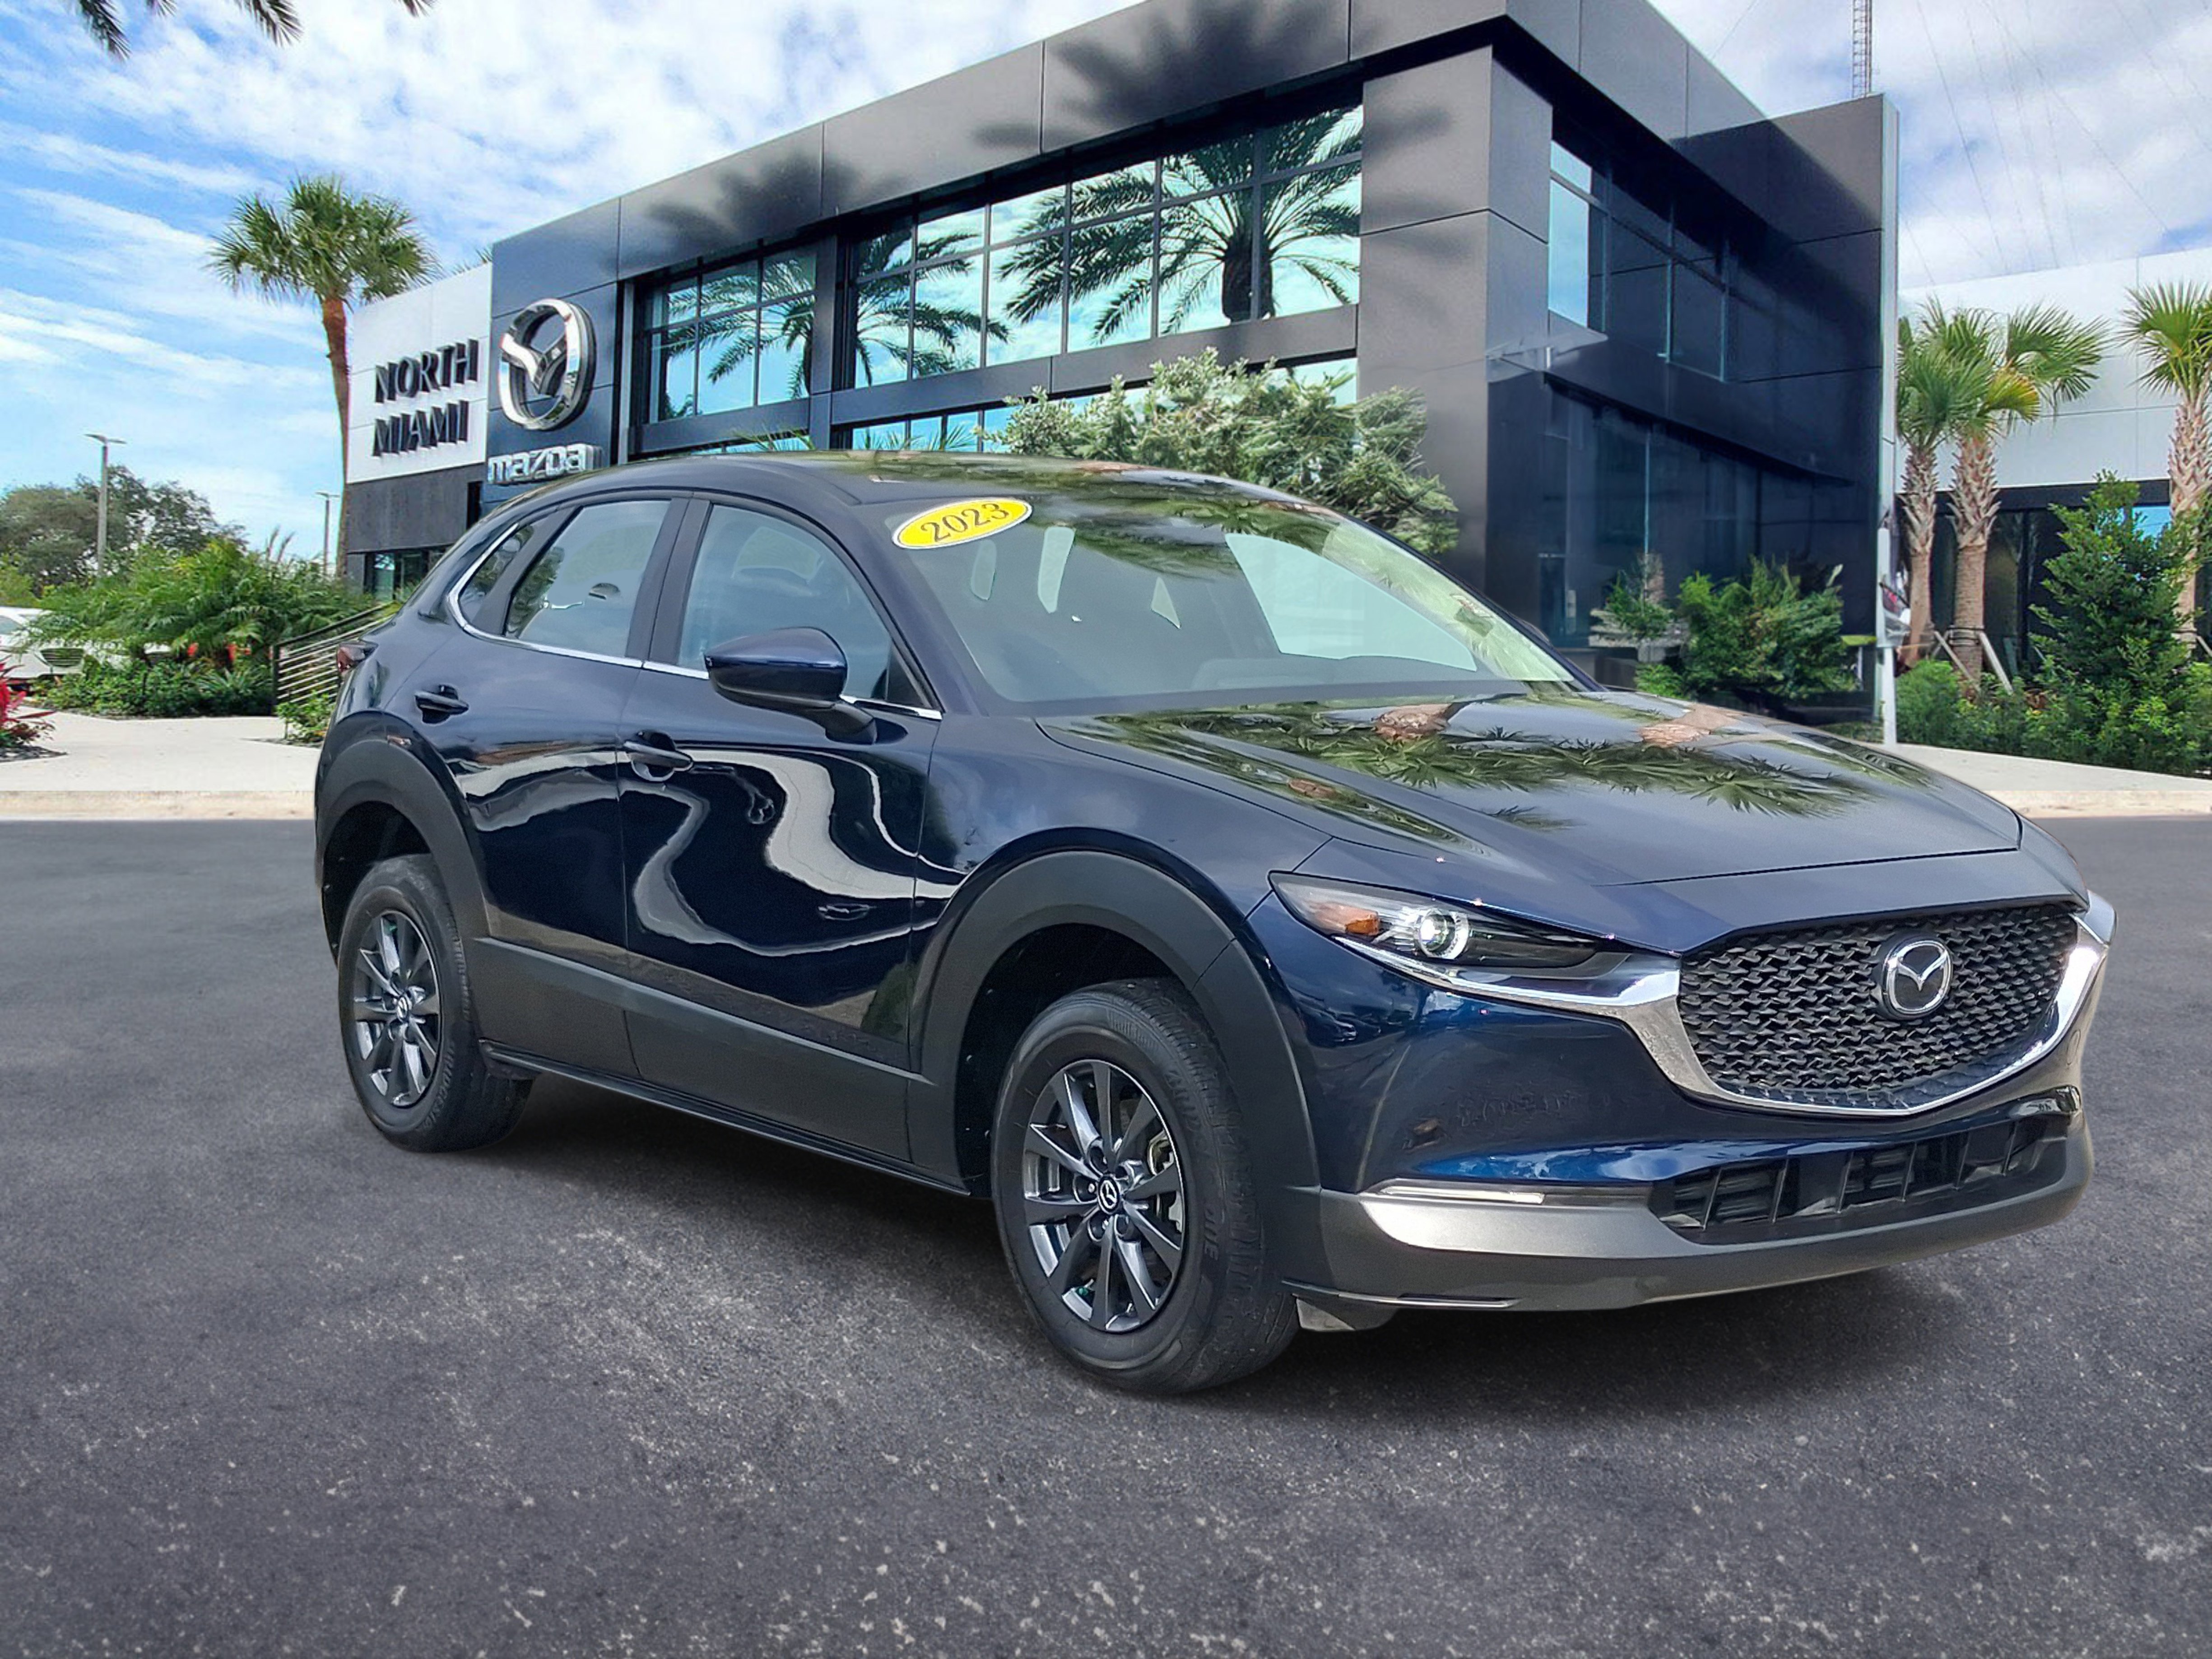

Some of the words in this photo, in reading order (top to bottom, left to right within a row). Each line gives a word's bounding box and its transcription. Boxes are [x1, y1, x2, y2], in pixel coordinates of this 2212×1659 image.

[375, 339, 479, 404] NORTH
[372, 400, 469, 457] MIAMI
[488, 443, 594, 484] mazda
[920, 503, 1009, 542] 2023
